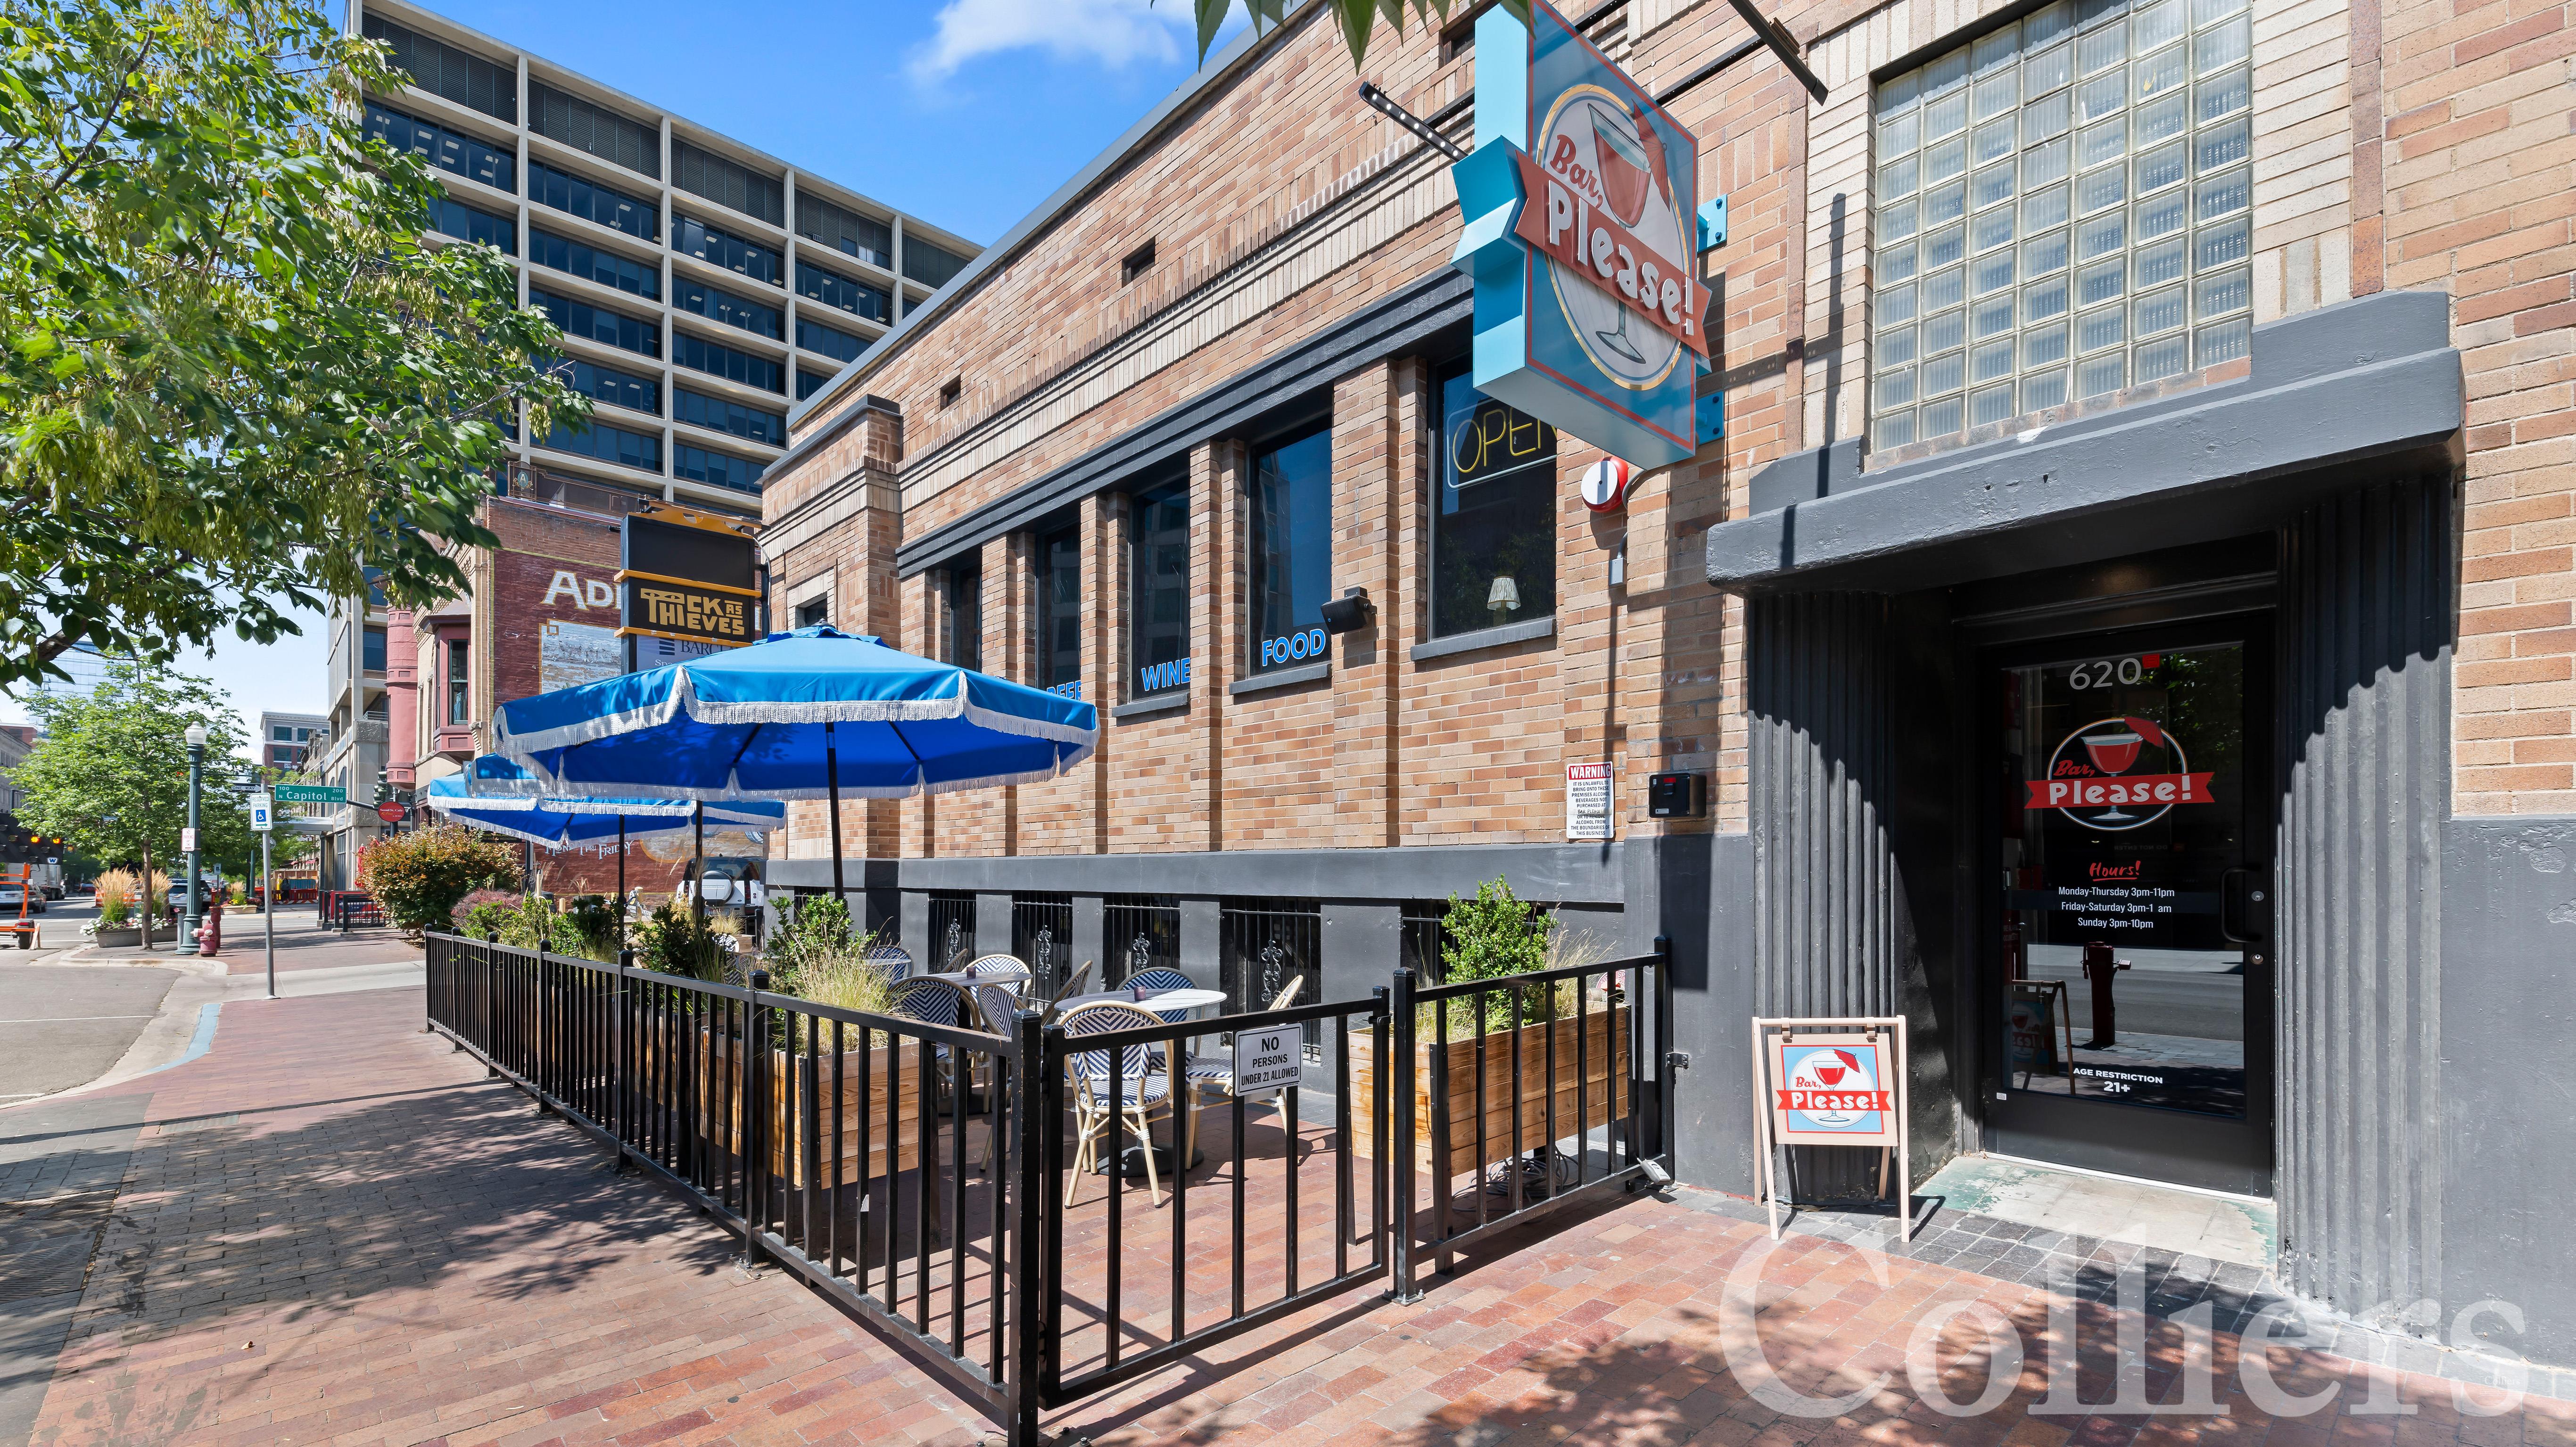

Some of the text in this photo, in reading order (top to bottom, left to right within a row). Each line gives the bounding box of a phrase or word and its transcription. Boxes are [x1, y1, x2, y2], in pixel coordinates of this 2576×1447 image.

[1550, 134, 1603, 209] Bar,
[1548, 179, 1693, 335] Please!
[1262, 629, 1326, 666] FOOD
[1141, 658, 1190, 691] WINE
[2069, 658, 2142, 690] 620
[1570, 765, 1610, 779] WARNING
[2053, 759, 2096, 777] Bar,
[287, 791, 327, 801] Capitol
[2048, 775, 2191, 805] Please!
[598, 840, 634, 860] FRIDY
[2089, 861, 2141, 878] Hours!
[2059, 887, 2175, 898] Monday-Thursday 3pm-11pm
[2062, 902, 2125, 913] Friday-Saturday
[2127, 903, 2153, 913] 3pm-1
[2078, 917, 2154, 929] Sunday 3pm-10pm
[1262, 1036, 1280, 1052] NO
[1252, 1053, 1288, 1068] PERSONS
[1241, 1066, 1298, 1086] UNDER 21 ALLOWED
[1795, 1077, 1822, 1090] Bar,
[2073, 1068, 2163, 1084] AGE RESTRICTION
[2104, 1081, 2130, 1093] 21+
[1791, 1091, 1879, 1109] Please!
